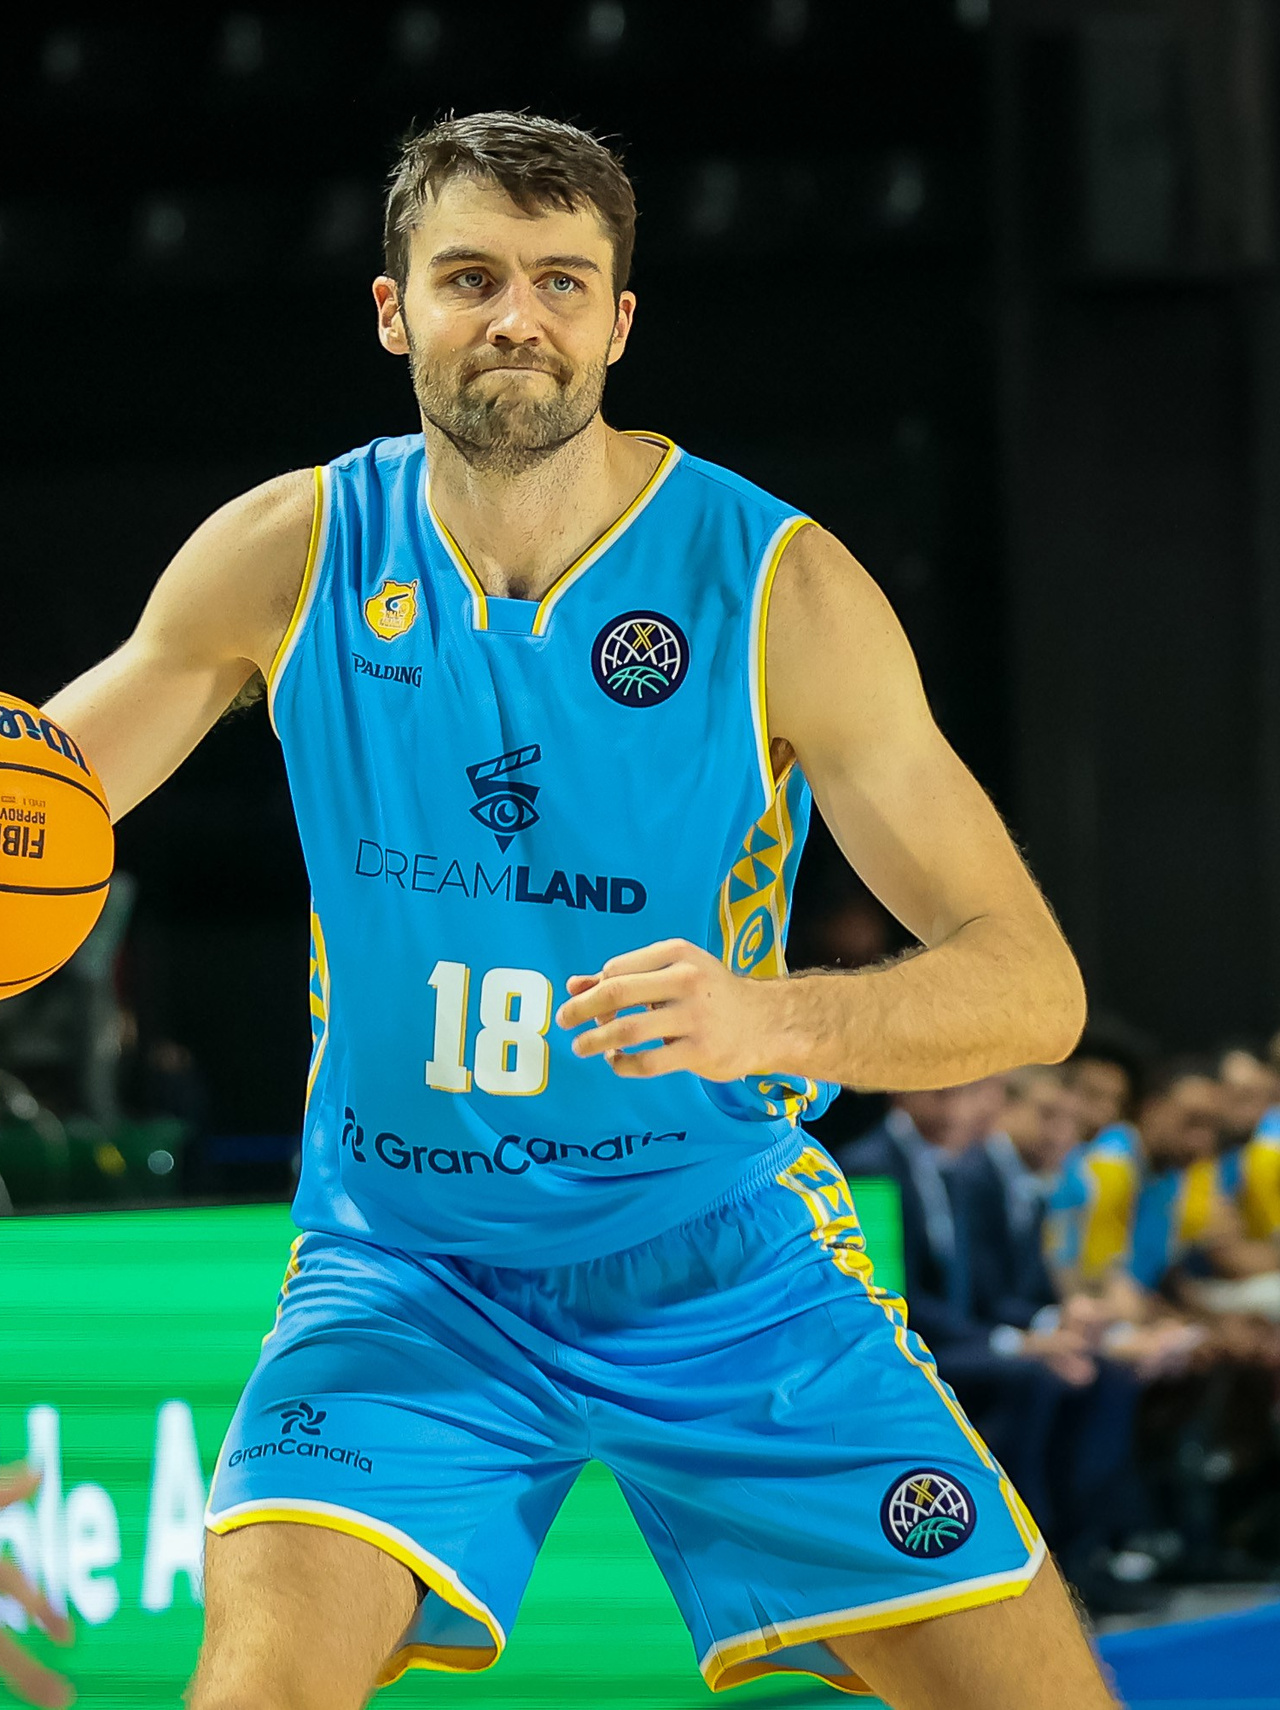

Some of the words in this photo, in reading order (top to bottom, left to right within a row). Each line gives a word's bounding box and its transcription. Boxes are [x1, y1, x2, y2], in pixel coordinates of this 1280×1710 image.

[355, 838, 648, 915] DREAMLAND
[425, 960, 554, 1097] 18
[228, 1438, 373, 1474] GranCanaria
